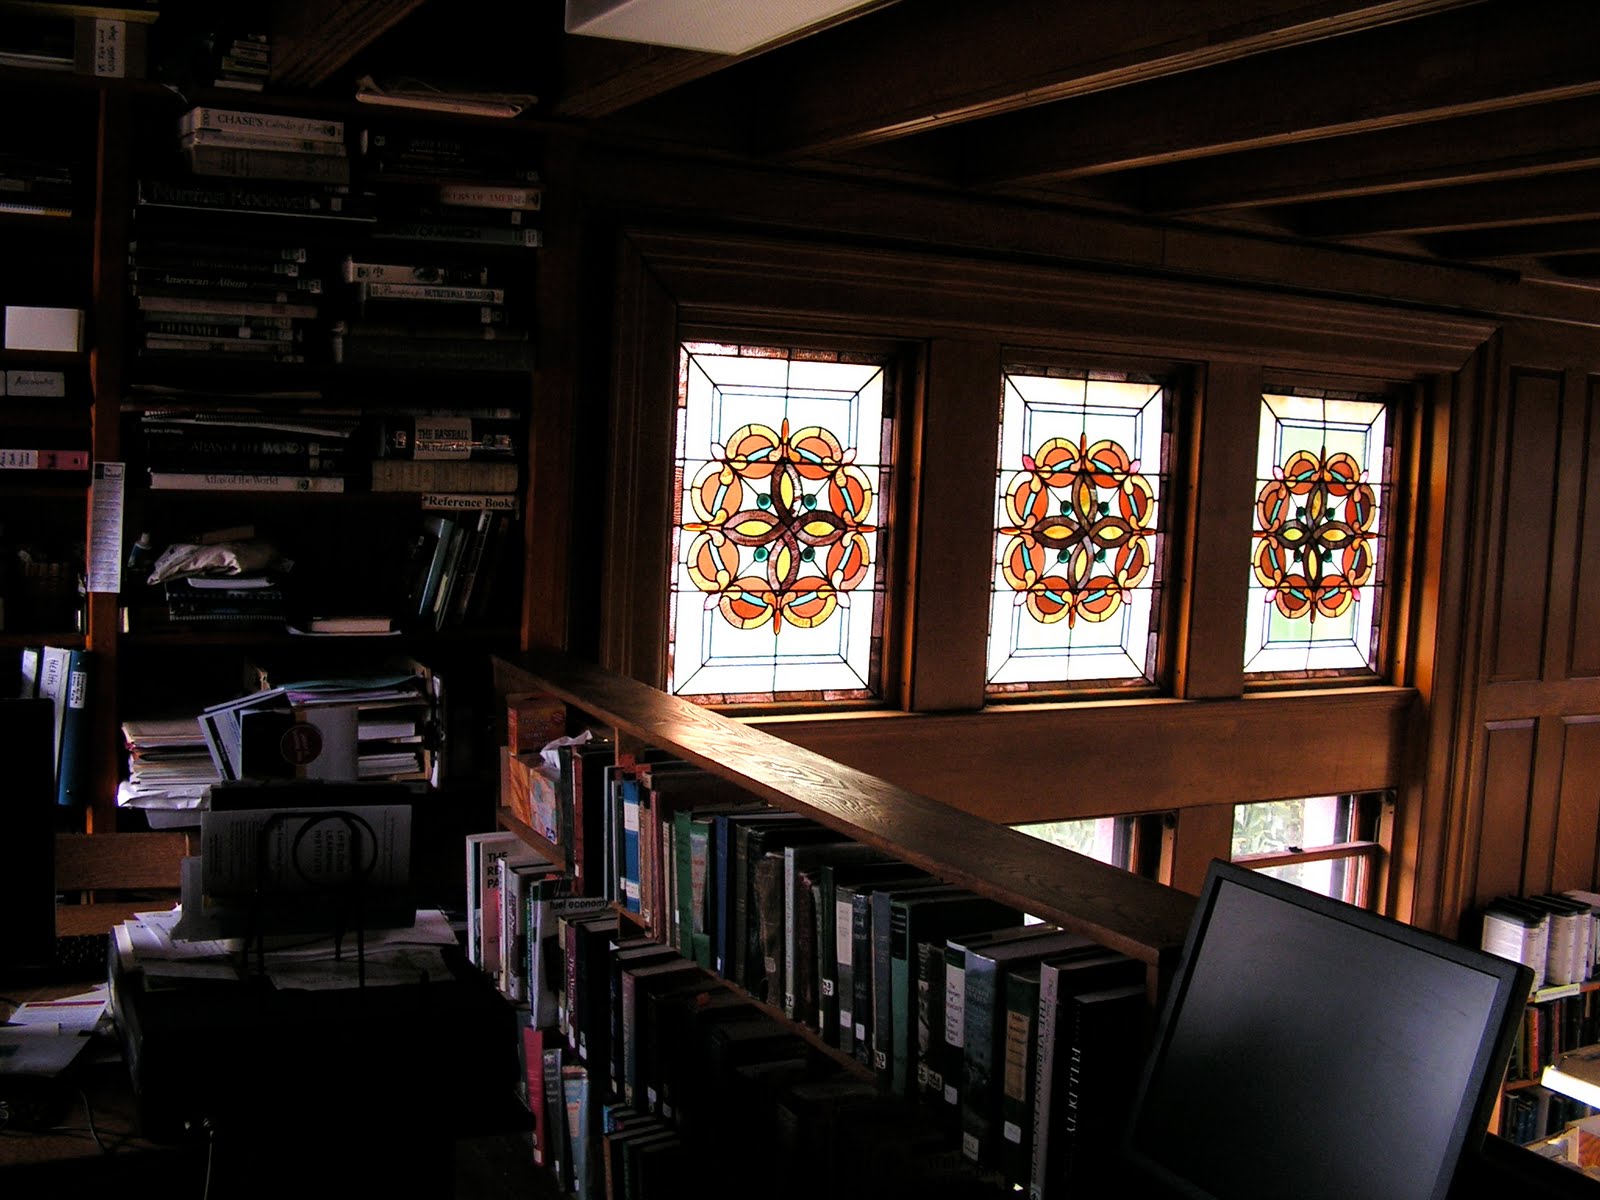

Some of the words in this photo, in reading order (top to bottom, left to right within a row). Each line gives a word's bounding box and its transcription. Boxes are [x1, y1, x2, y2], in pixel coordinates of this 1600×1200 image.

[163, 274, 209, 286] American
[216, 277, 248, 288] Album
[417, 428, 433, 440] THE
[434, 428, 469, 440] BASEBALL
[204, 474, 227, 484] Atlas
[228, 474, 237, 484] of
[237, 475, 251, 484] the
[252, 475, 279, 485] World
[428, 495, 482, 508] Reference
[485, 497, 516, 509] Books
[487, 851, 508, 862] THE
[549, 899, 566, 910] fuel
[568, 899, 609, 910] economy
[1069, 1045, 1081, 1088] FULL
[1066, 1091, 1079, 1133] DUTY
